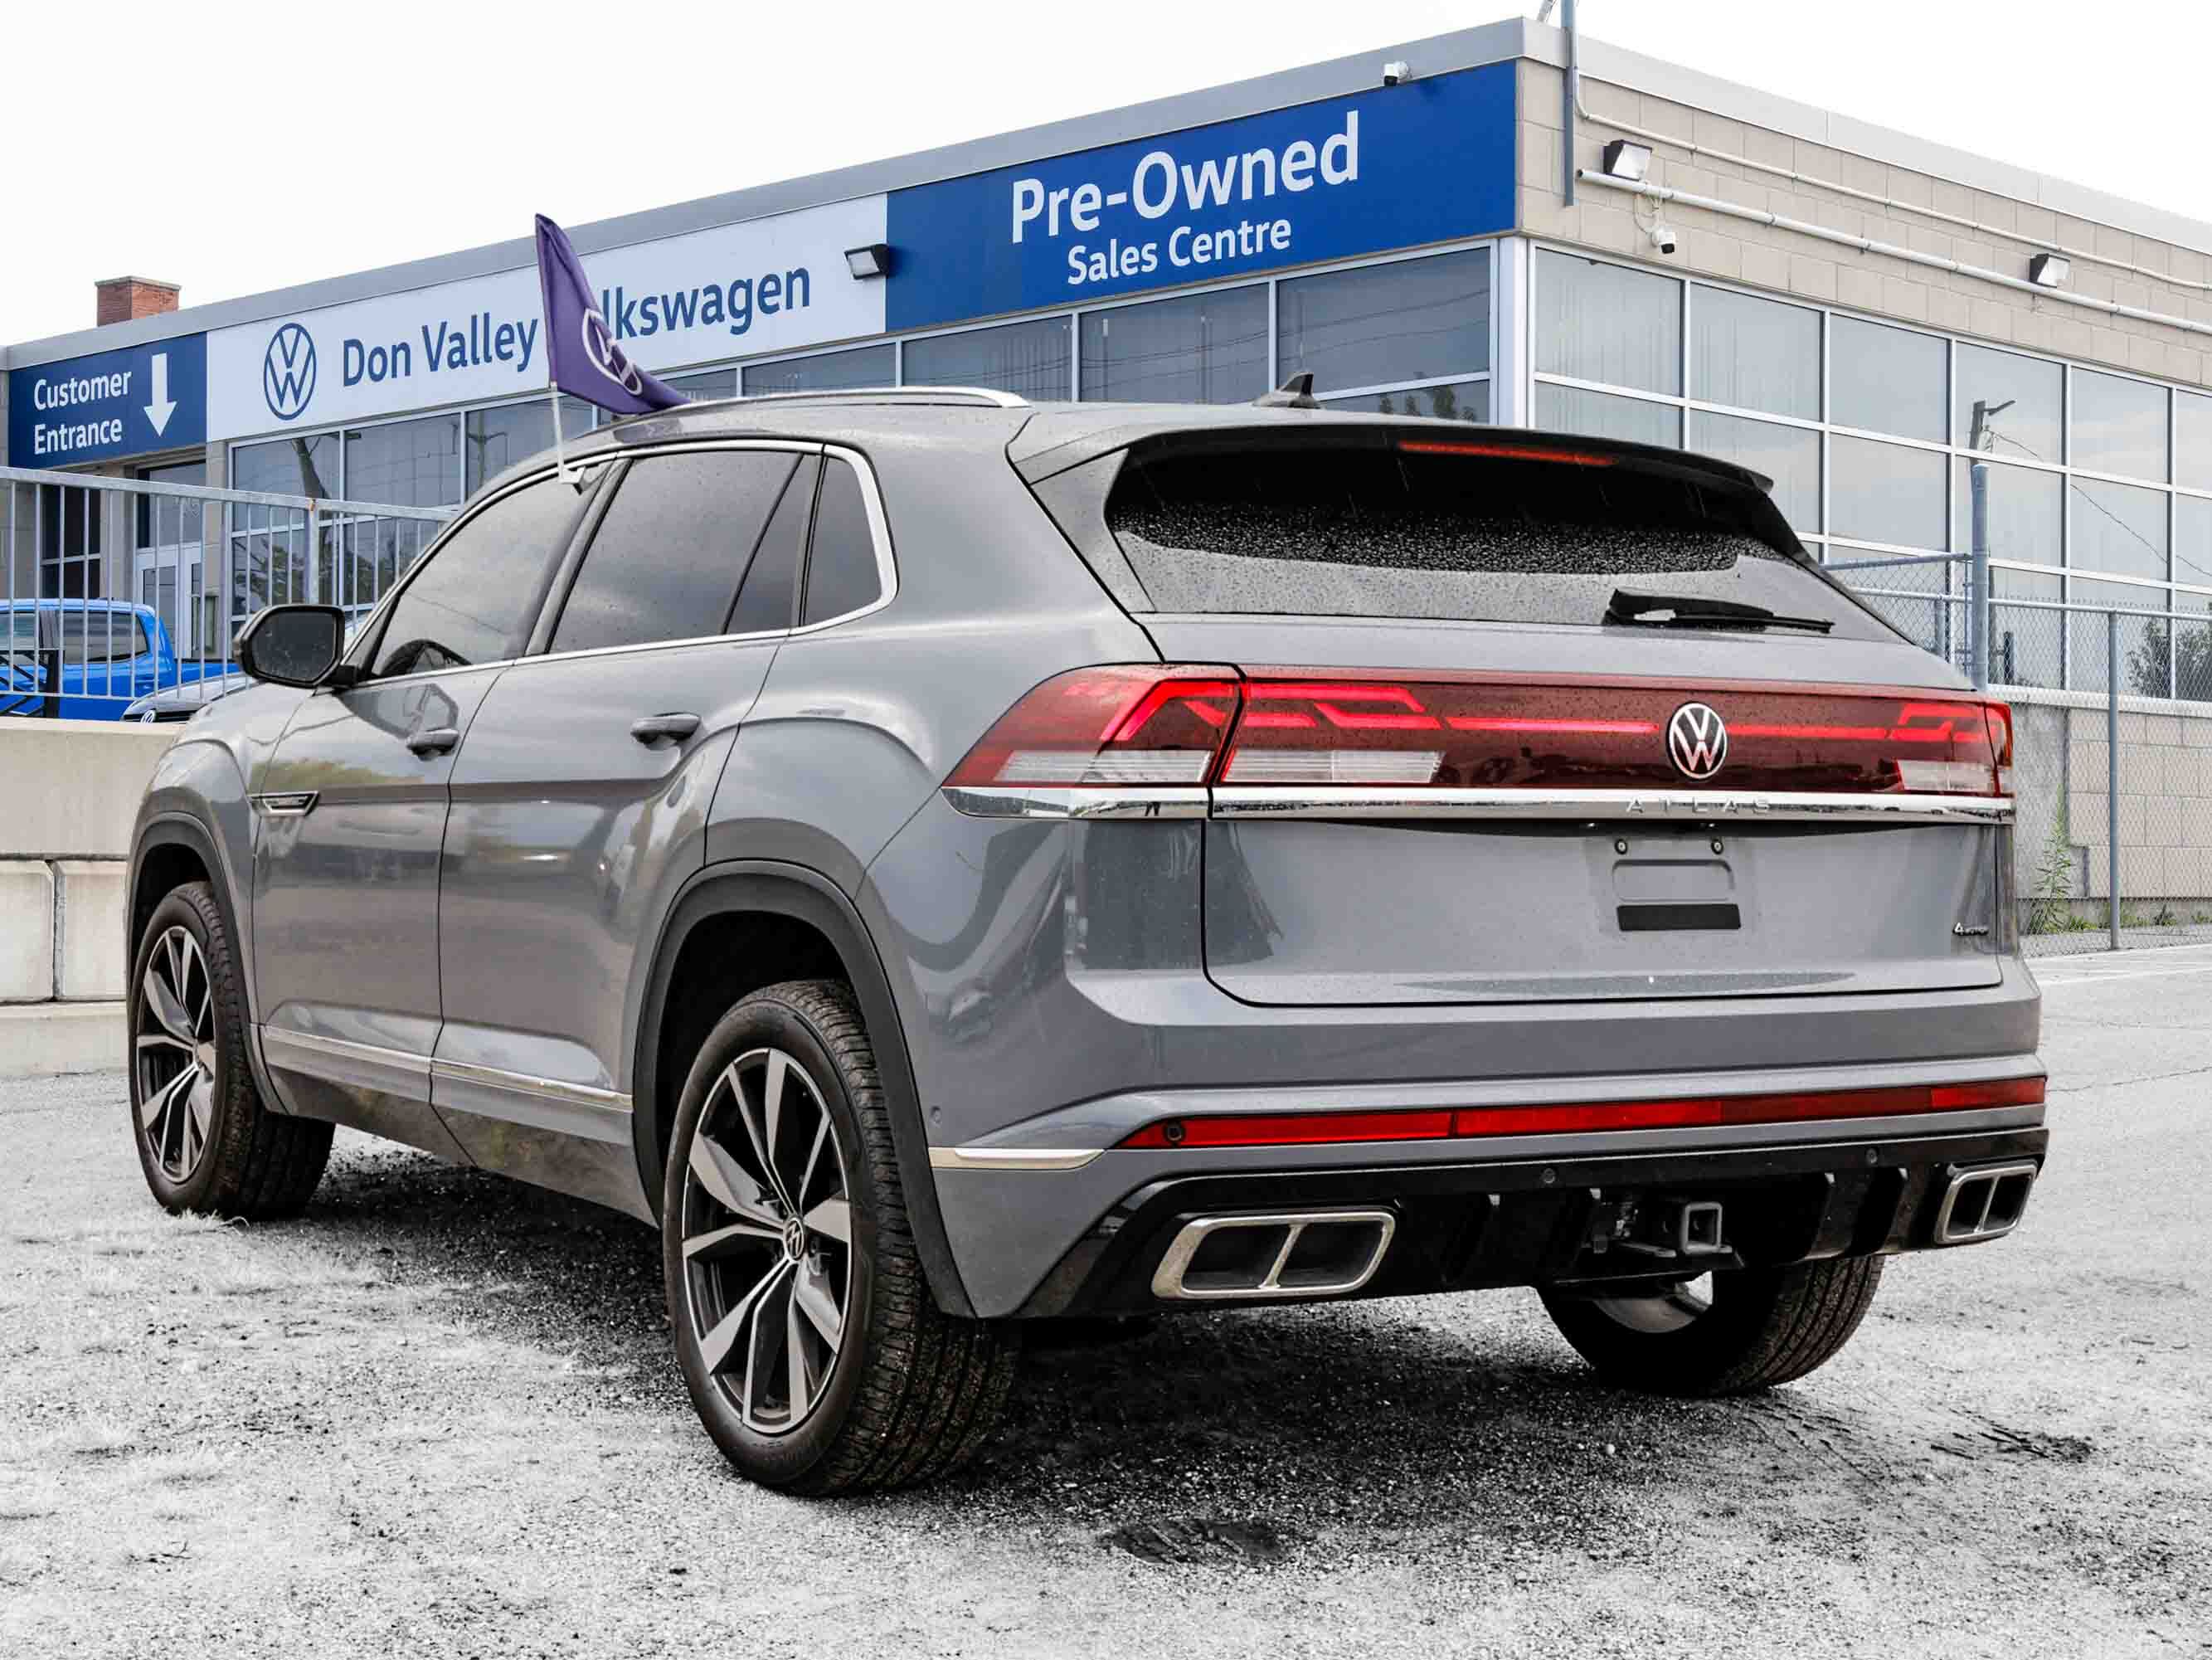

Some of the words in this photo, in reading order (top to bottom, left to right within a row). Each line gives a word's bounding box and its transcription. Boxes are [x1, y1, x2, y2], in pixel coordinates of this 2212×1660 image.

[1012, 110, 1359, 245] Pre-Owned
[1067, 239, 1158, 285] Sales
[1168, 218, 1292, 266] Centre
[342, 338, 412, 387] Don
[421, 312, 539, 373] Valley
[602, 266, 810, 340] lkswagen
[34, 368, 132, 411] Customer
[264, 323, 317, 421] VW
[34, 418, 123, 455] Entrance
[1668, 702, 1728, 780] VW
[1626, 796, 1770, 815] ATLAS
